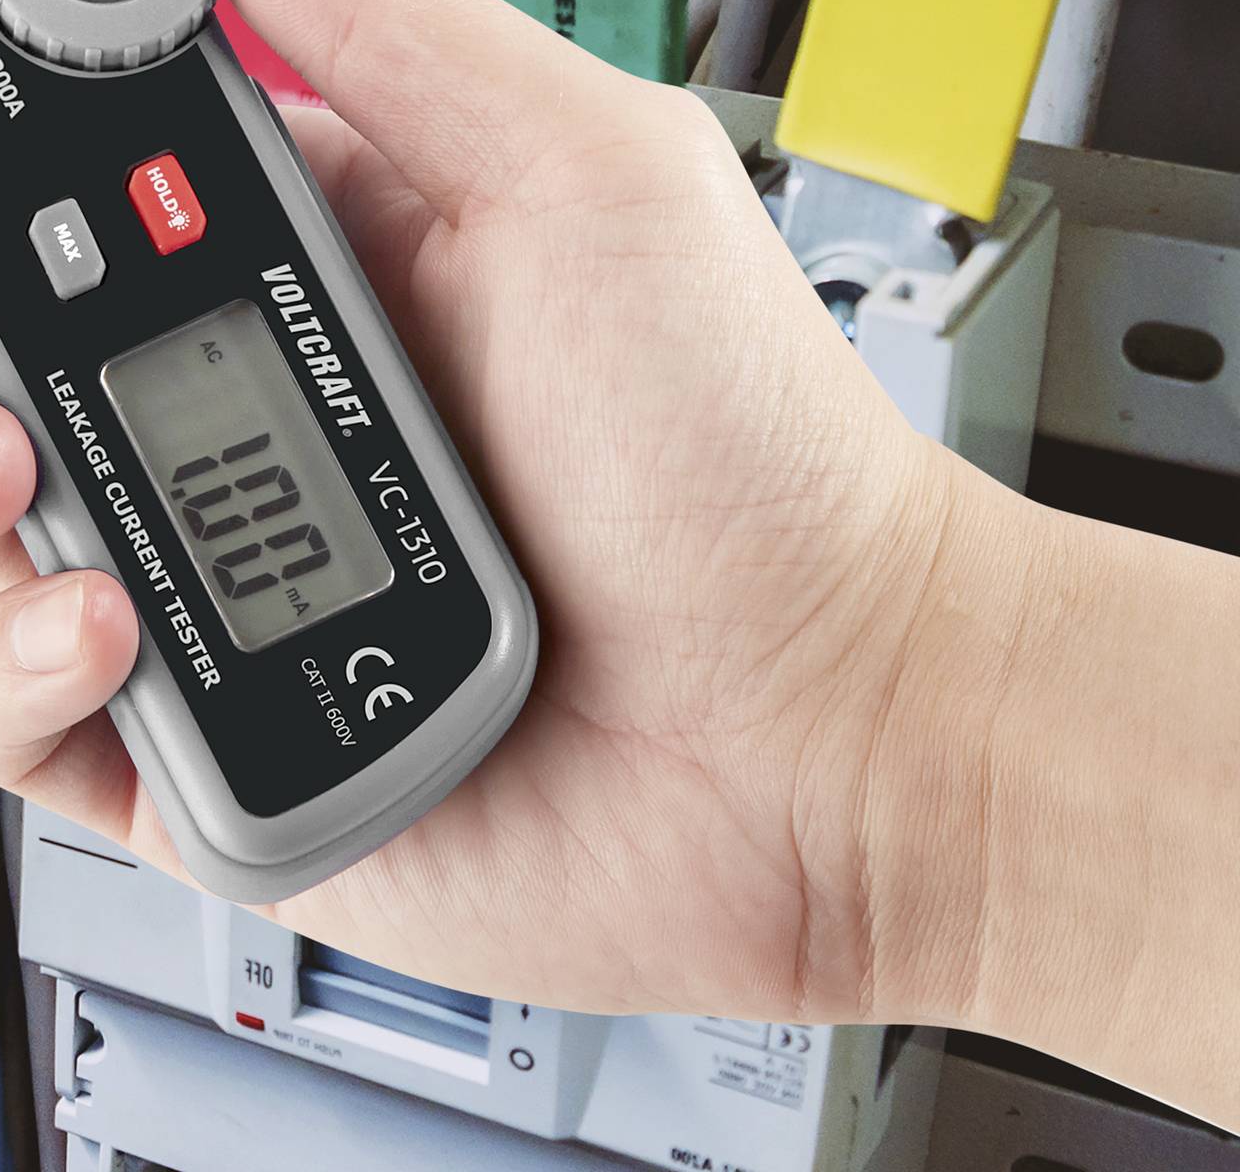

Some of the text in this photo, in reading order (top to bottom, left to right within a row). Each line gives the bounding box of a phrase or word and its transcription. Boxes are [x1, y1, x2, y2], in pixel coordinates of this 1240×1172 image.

[146, 166, 179, 214] HOLD
[53, 222, 82, 263] MAX
[198, 339, 224, 364] AC
[46, 369, 221, 691] LEAKAGE CURRENT TESTER
[369, 460, 447, 584] VC-1310
[285, 587, 312, 618] mA
[301, 658, 327, 687] CAT
[326, 707, 357, 747] 600V
